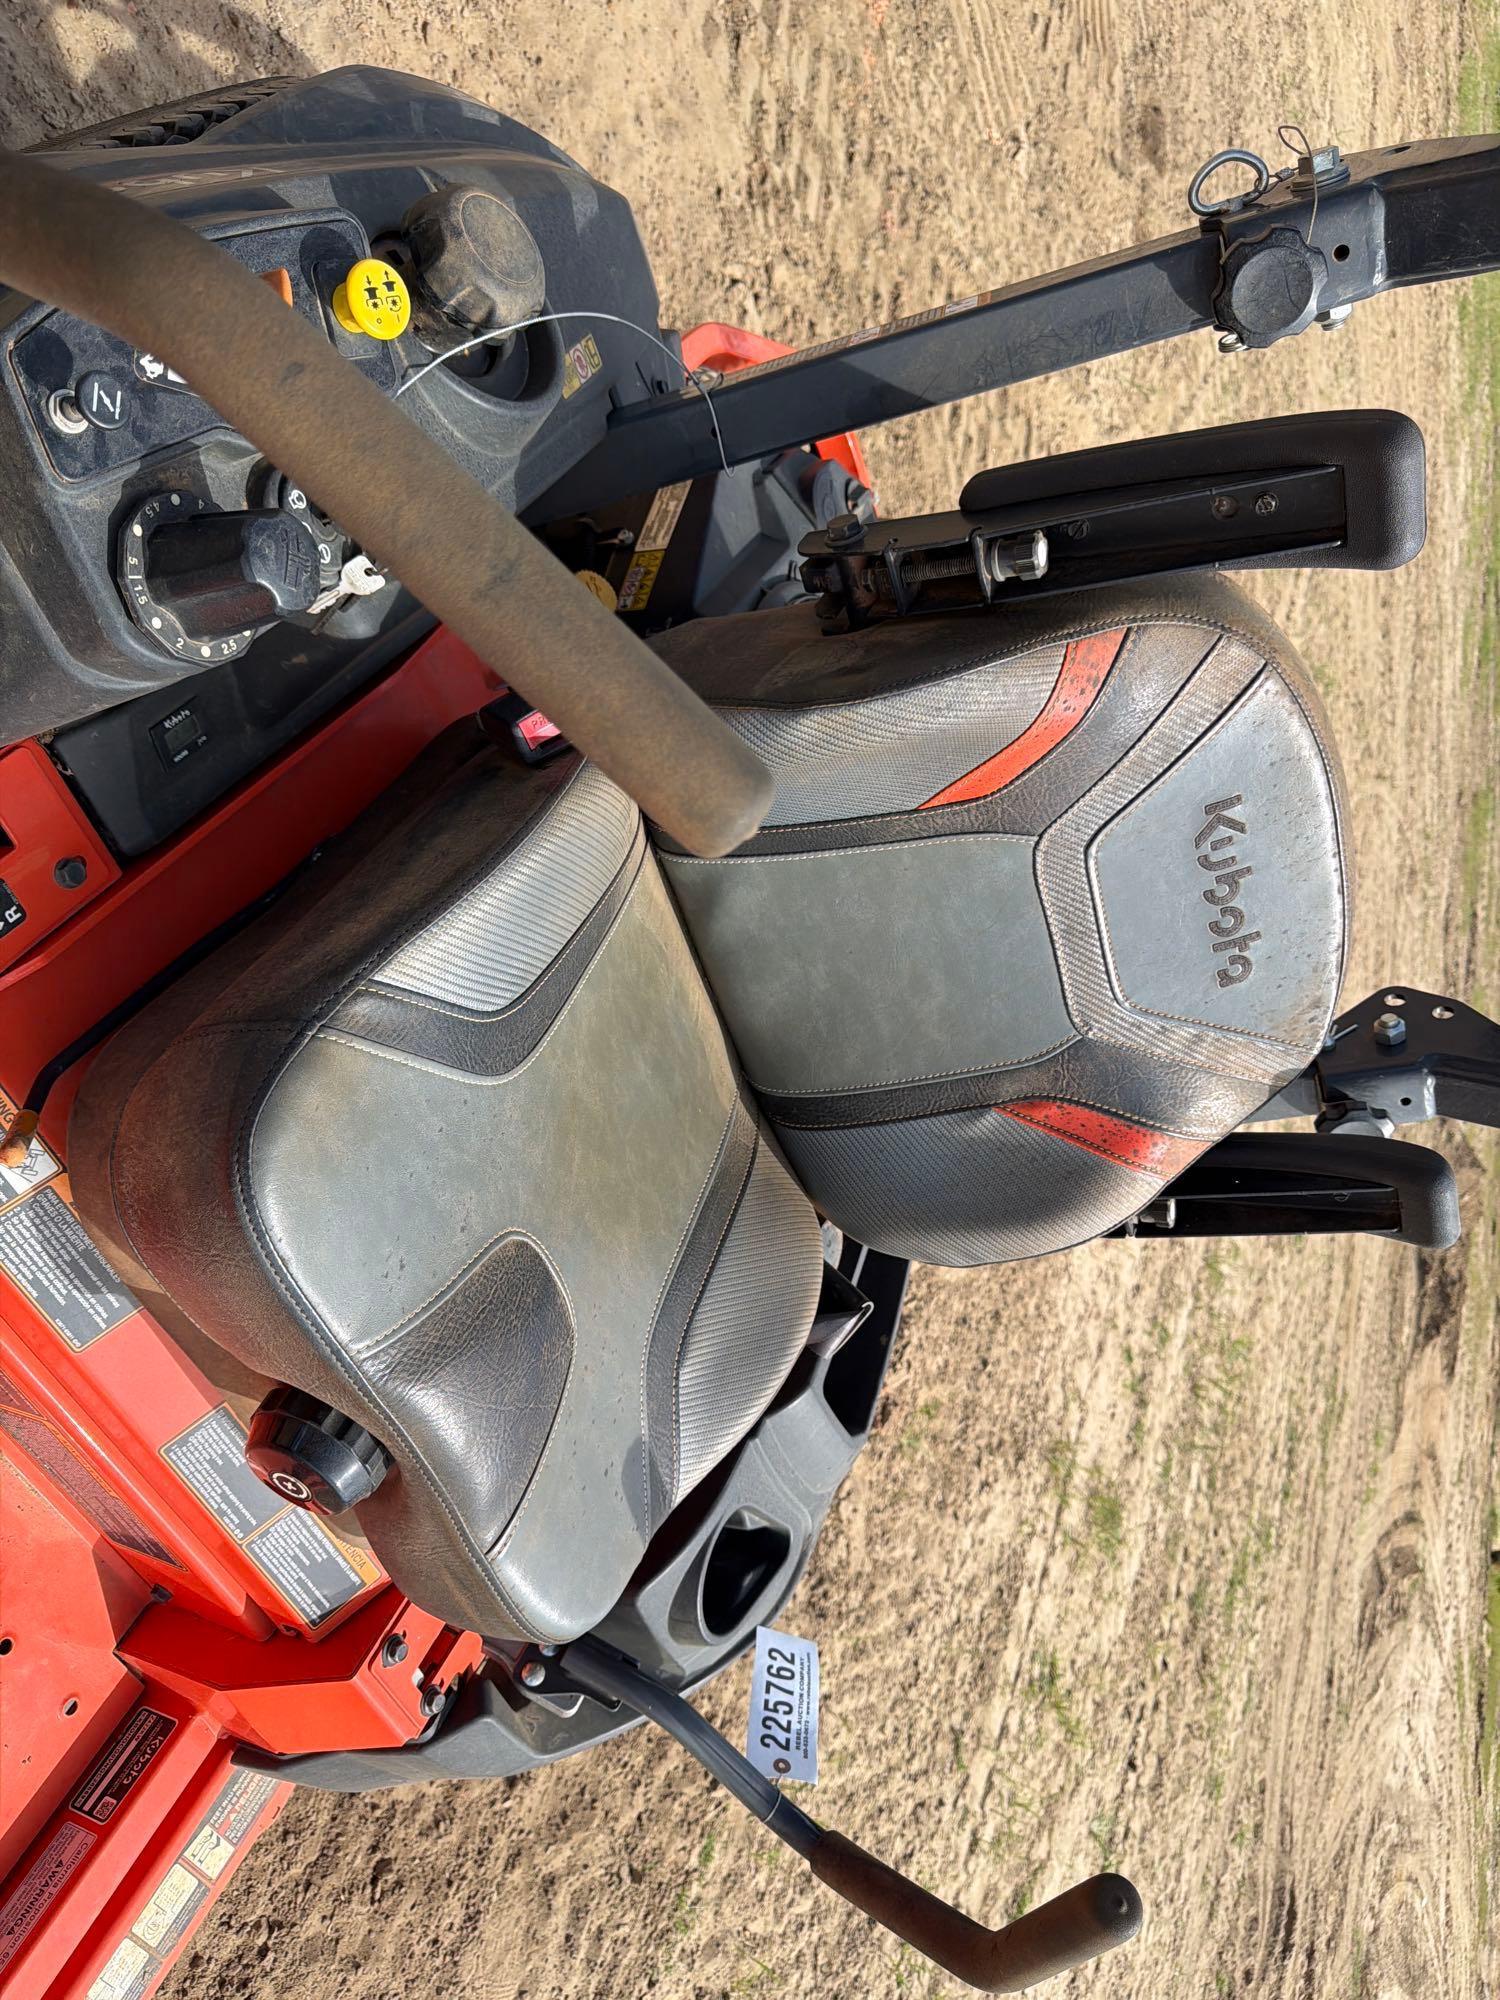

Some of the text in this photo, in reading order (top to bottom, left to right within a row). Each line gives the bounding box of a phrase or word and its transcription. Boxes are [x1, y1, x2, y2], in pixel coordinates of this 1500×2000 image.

[145, 501, 160, 518] 4.5
[128, 556, 138, 566] 5
[133, 584, 148, 605] 1.5
[176, 638, 185, 650] 2
[221, 639, 238, 655] 2.5
[1194, 794, 1262, 988] Kubota
[4, 905, 22, 924] R
[760, 1648, 795, 1752] 225762
[797, 1692, 805, 1724] AUCTION
[121, 1733, 164, 1786] Kubota
[52, 1841, 88, 1889] California
[12, 1867, 58, 1928] WARNING
[8, 1890, 53, 1949] Proposition
